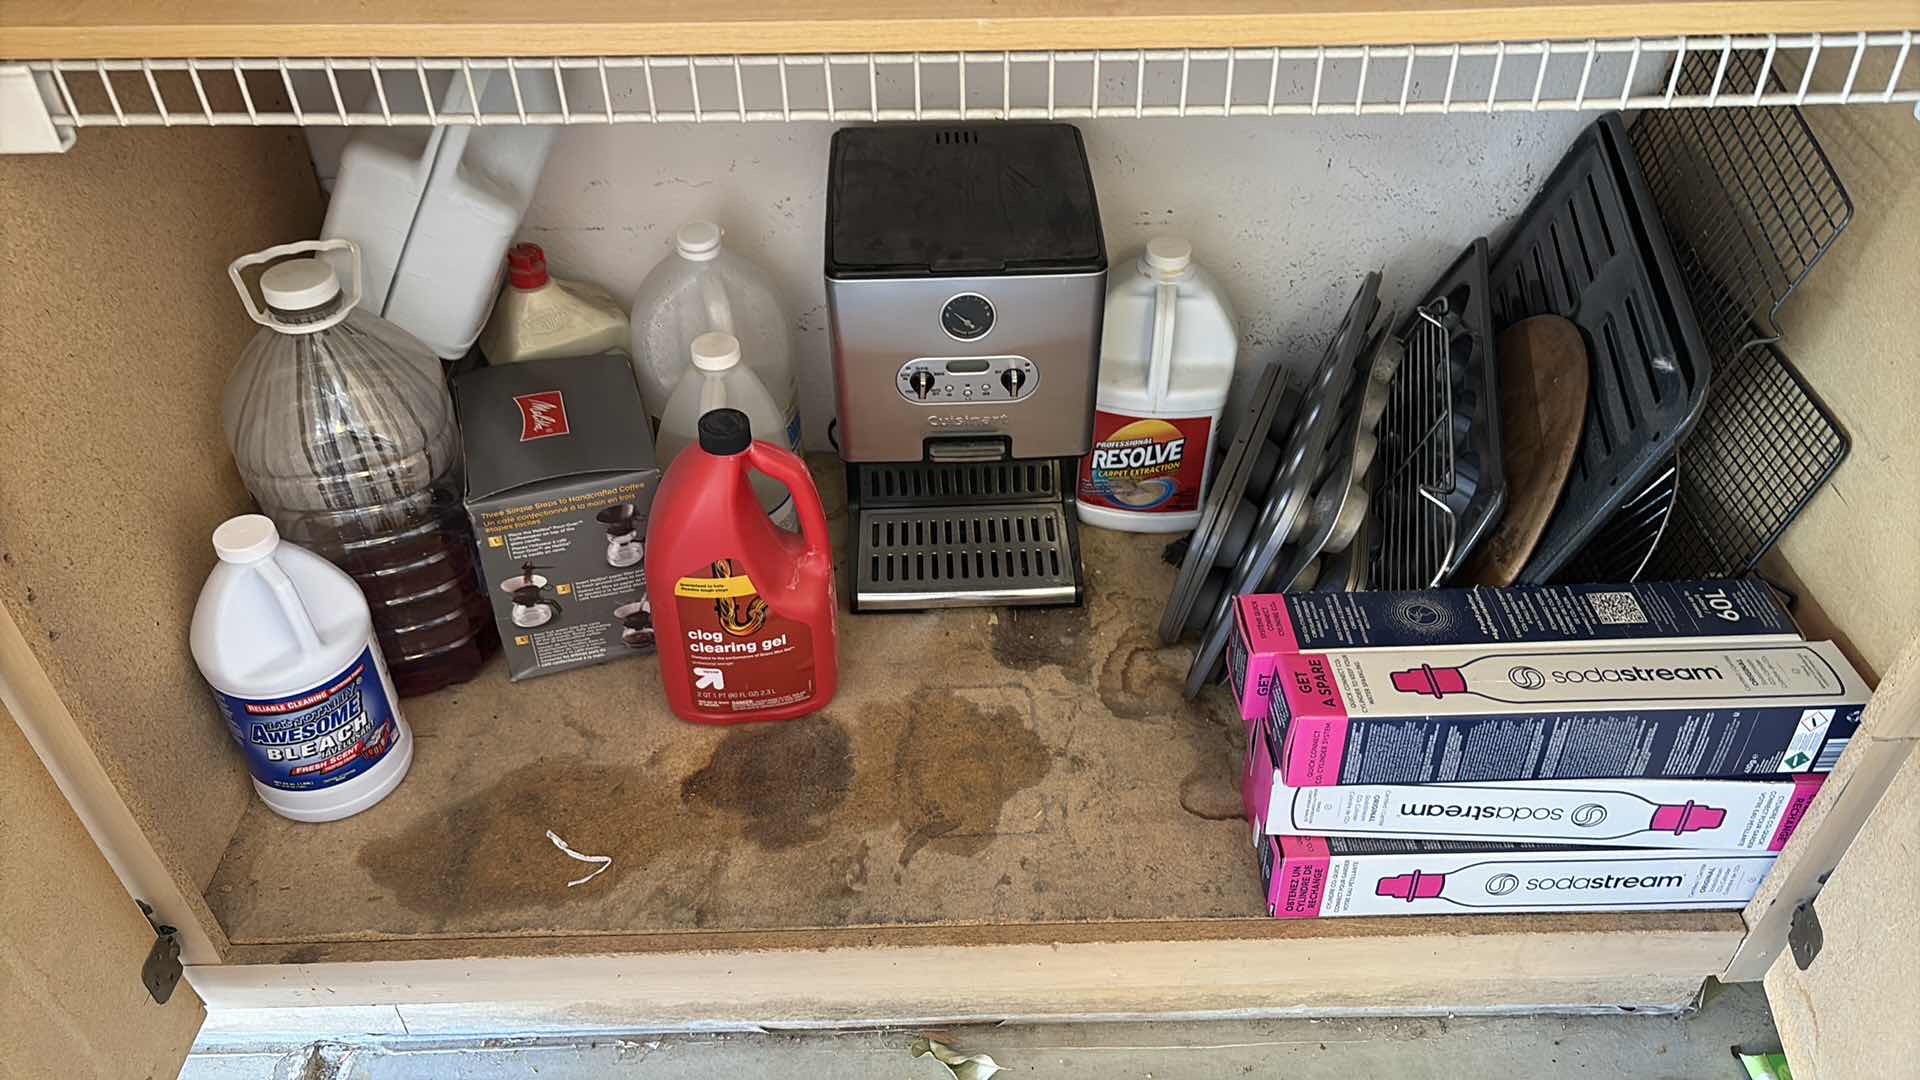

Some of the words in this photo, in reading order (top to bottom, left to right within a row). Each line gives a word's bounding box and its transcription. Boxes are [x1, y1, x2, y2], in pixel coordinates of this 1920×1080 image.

[927, 413, 1009, 427] Cuisinart
[1096, 438, 1153, 449] PROFESSIONAL
[1091, 439, 1185, 469] RESOLVE
[1098, 468, 1130, 478] CARPET
[1130, 461, 1181, 477] EXTRACTION
[619, 482, 645, 493] Coffee
[687, 629, 723, 642] clog
[689, 642, 757, 653] clearing
[762, 634, 787, 650] gel
[1294, 672, 1313, 694] GET
[1309, 659, 1333, 697] SPARE
[1551, 664, 1724, 683] sodastream
[1257, 673, 1271, 696] GET
[247, 704, 287, 714] RELIABLE
[288, 691, 328, 709] CLEANING
[1322, 698, 1337, 708] A
[1345, 692, 1357, 708] QUICK
[251, 689, 365, 744] AWESOME
[267, 710, 369, 761] BLEACH
[296, 761, 328, 774] FRESH
[328, 744, 360, 767] SCENT
[1400, 803, 1565, 821] sodastream
[1285, 879, 1299, 911] OBTENEZ
[1292, 865, 1301, 878] UN
[1296, 877, 1310, 912] CYLINDRE
[1304, 864, 1313, 876] DE
[1307, 868, 1323, 909] RECHANGE
[1526, 873, 1684, 890] sodastream
